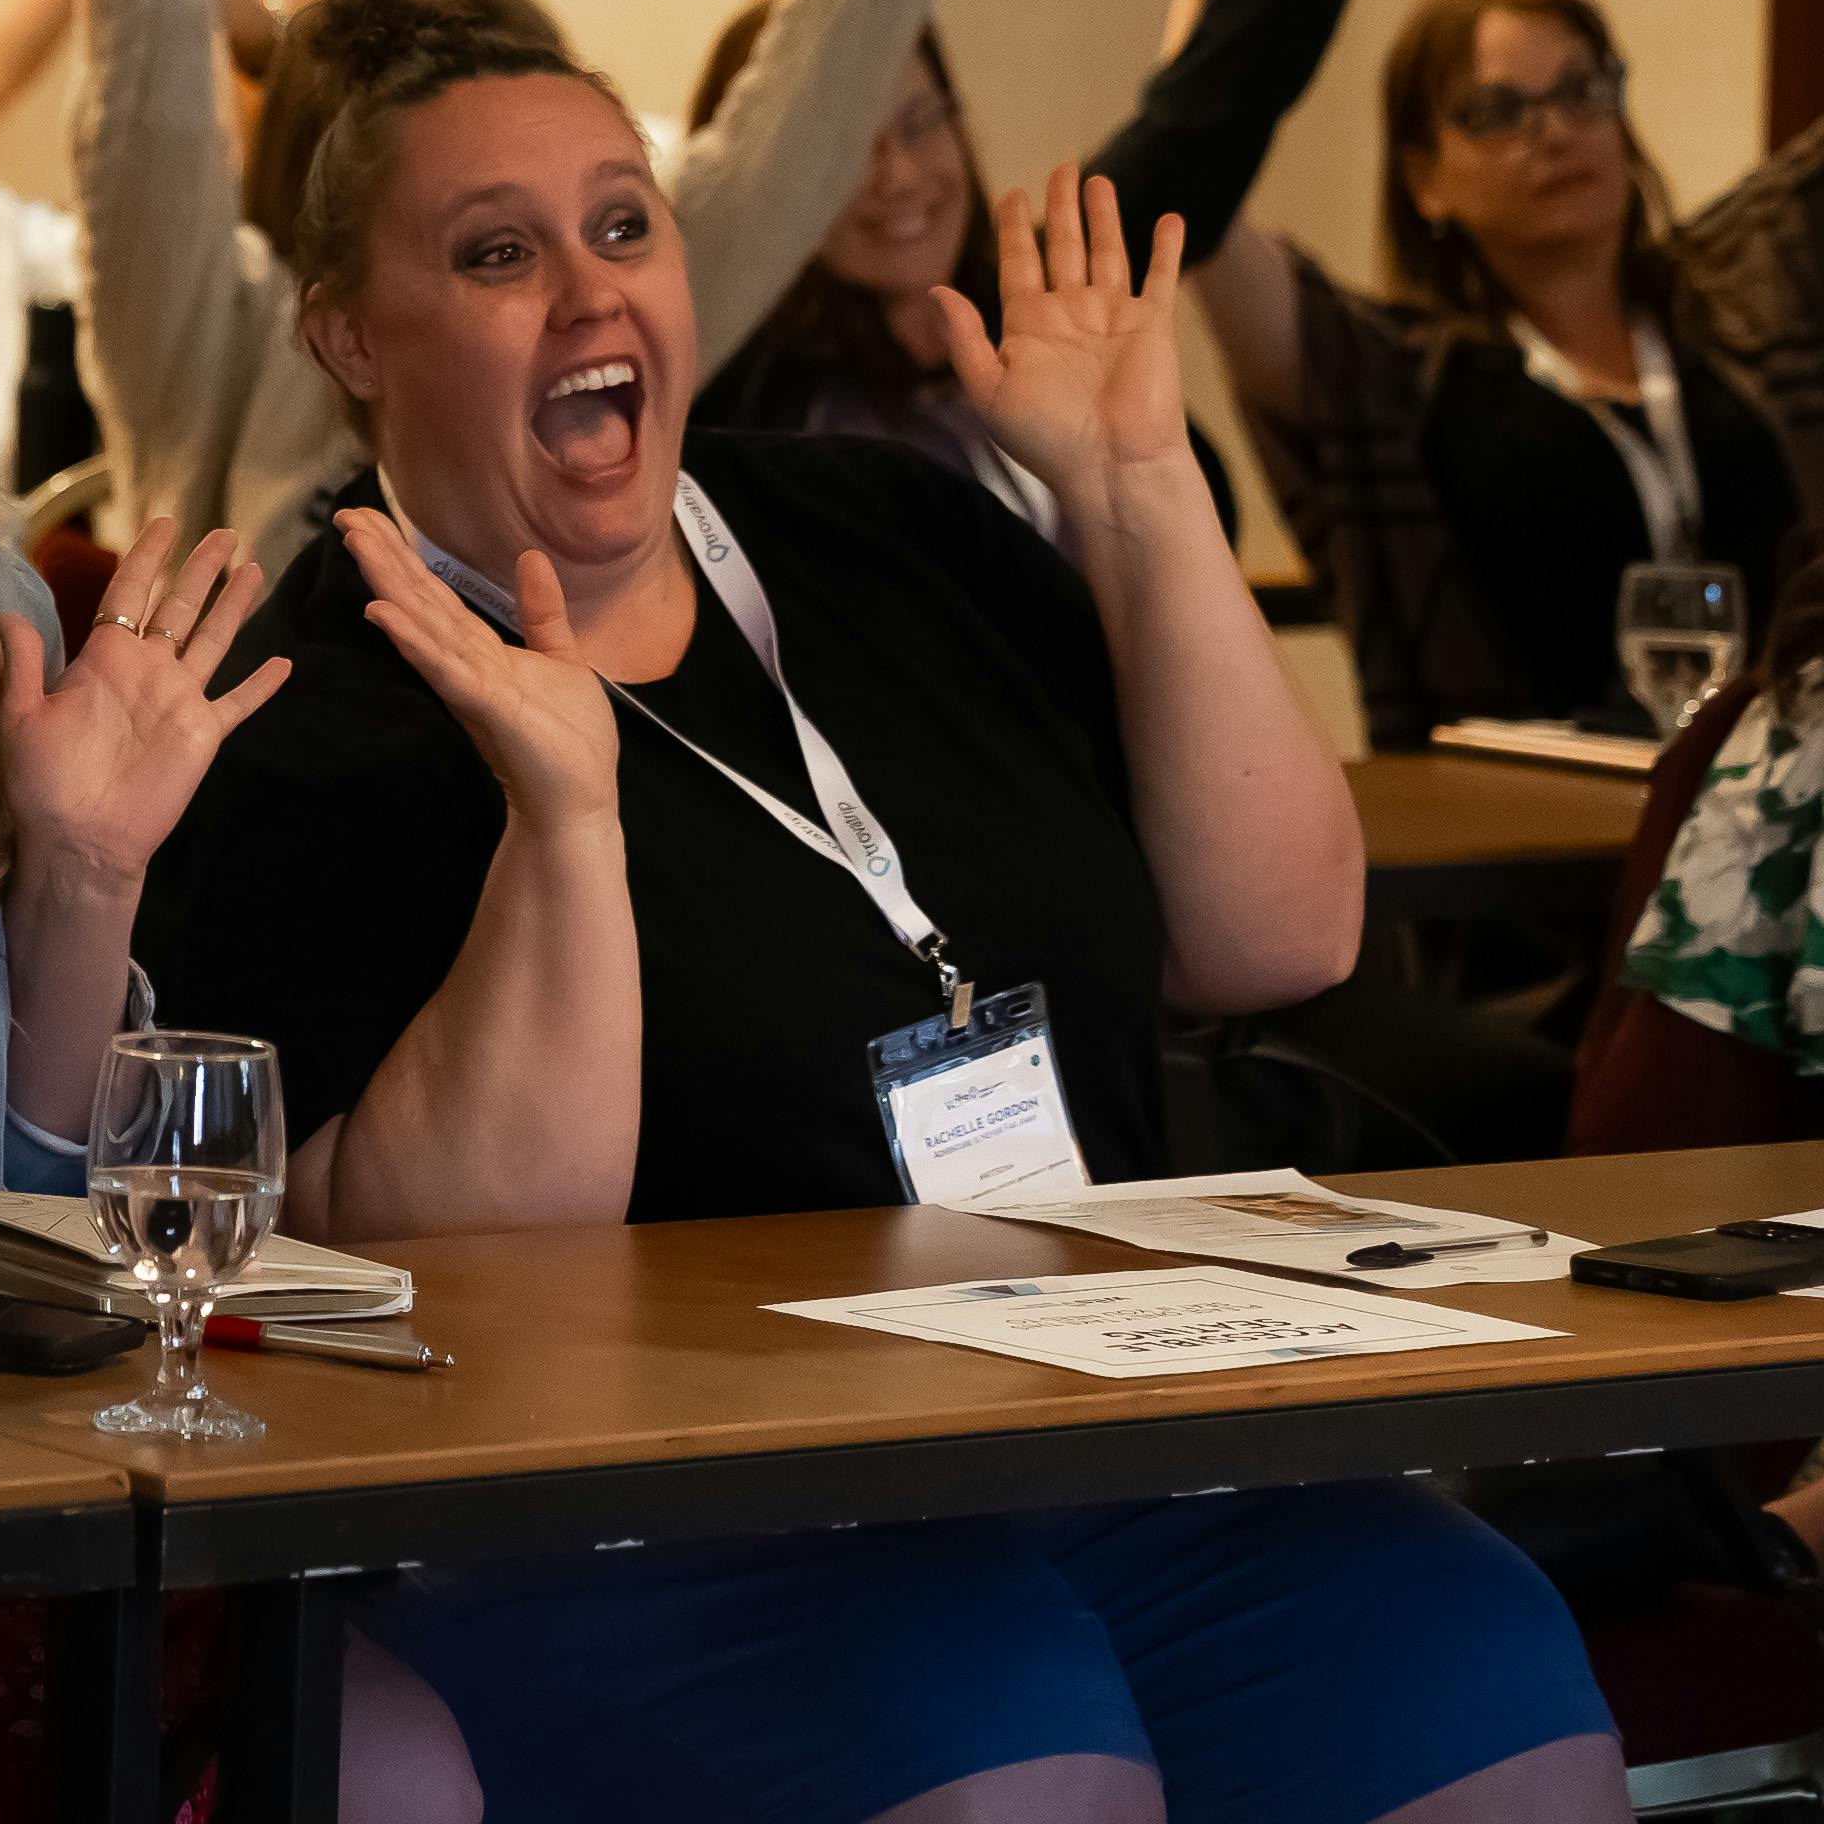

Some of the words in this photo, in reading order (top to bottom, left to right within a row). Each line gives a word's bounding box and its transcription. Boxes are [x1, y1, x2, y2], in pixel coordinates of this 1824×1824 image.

[987, 1097, 1040, 1125] GORDON
[1101, 1318, 1292, 1341] SEATING
[1104, 1322, 1361, 1353] ACCESSIBLE
